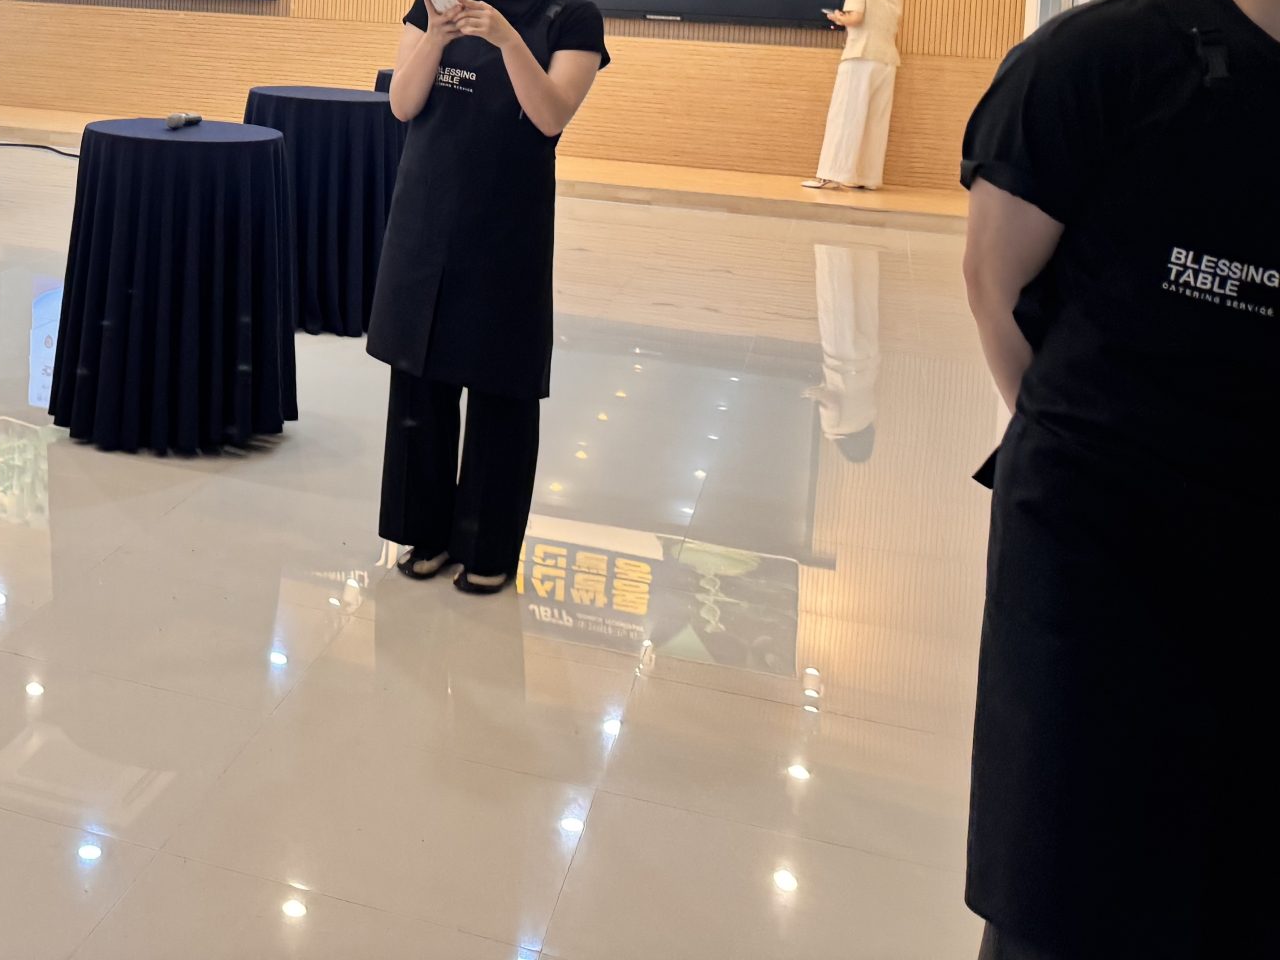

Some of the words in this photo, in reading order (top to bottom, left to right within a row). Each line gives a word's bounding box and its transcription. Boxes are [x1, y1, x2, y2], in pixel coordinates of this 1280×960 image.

[1168, 263, 1240, 296] TABLE
[1170, 247, 1280, 288] BLESSING
[1162, 282, 1220, 304] CATERING
[1226, 299, 1274, 317] SERVICE
